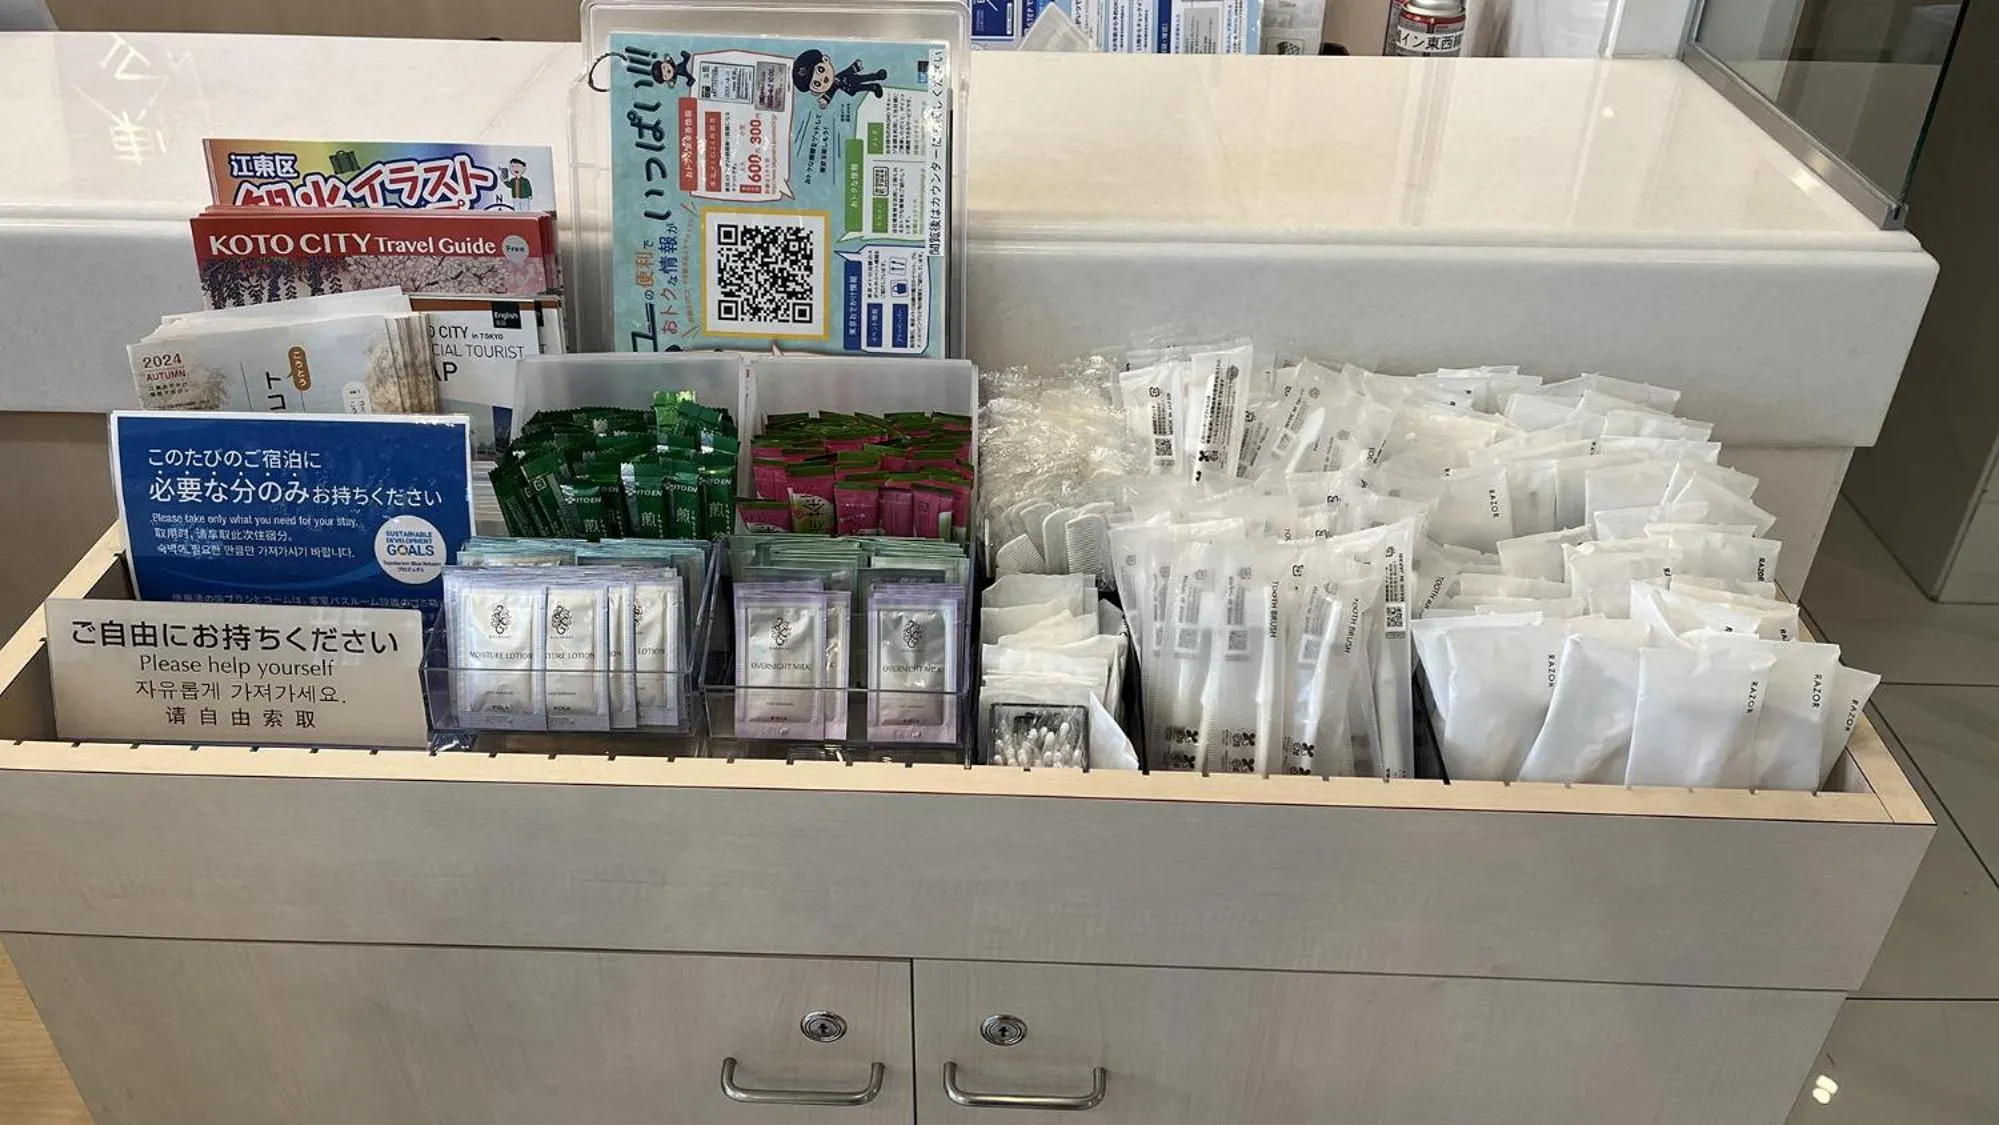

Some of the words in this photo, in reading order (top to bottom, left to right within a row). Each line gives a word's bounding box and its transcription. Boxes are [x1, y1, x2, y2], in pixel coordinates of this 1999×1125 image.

[230, 153, 298, 179] 江東区
[209, 233, 294, 255] KOTO
[300, 232, 371, 254] CITY
[375, 236, 433, 253] Travel
[439, 236, 496, 254] Guide
[658, 222, 679, 335] おトクな情報が
[439, 325, 469, 339] CITY
[142, 353, 182, 369] 2024
[464, 344, 526, 359] TOURIST
[146, 369, 186, 381] AUTUMN
[148, 448, 322, 470] このたびのご宿泊に
[149, 474, 443, 507] 必要な分のみお持ちください
[650, 489, 663, 497] EN
[673, 484, 687, 492] ITO
[686, 485, 698, 493] EN
[1489, 489, 1500, 518] RAZOR
[152, 512, 183, 525] Please
[184, 513, 205, 524] take
[207, 514, 227, 526] only
[229, 514, 252, 525] what
[255, 516, 271, 526] you
[274, 515, 296, 526] need
[387, 544, 434, 556] GOALS
[1271, 581, 1279, 608] TOOTH
[1429, 575, 1445, 600] TOOTH
[1269, 610, 1278, 638] BRUSH
[1351, 598, 1359, 625] TOOTH
[71, 619, 399, 655] ご自由にお持ちください
[1343, 625, 1356, 654] BRUSH
[505, 651, 533, 660] LOTION
[567, 651, 595, 660] LOTION
[638, 647, 665, 656] LOTION
[139, 654, 202, 674] Please
[208, 656, 251, 679] help
[256, 658, 335, 680] yourself
[1547, 654, 1556, 688] RAZOR
[135, 680, 221, 702] 자유롭게
[230, 682, 348, 705] 가져가세요.
[1746, 680, 1759, 714] RAZOR
[1811, 673, 1823, 709] RAZOR
[1844, 699, 1859, 732] RAZOR
